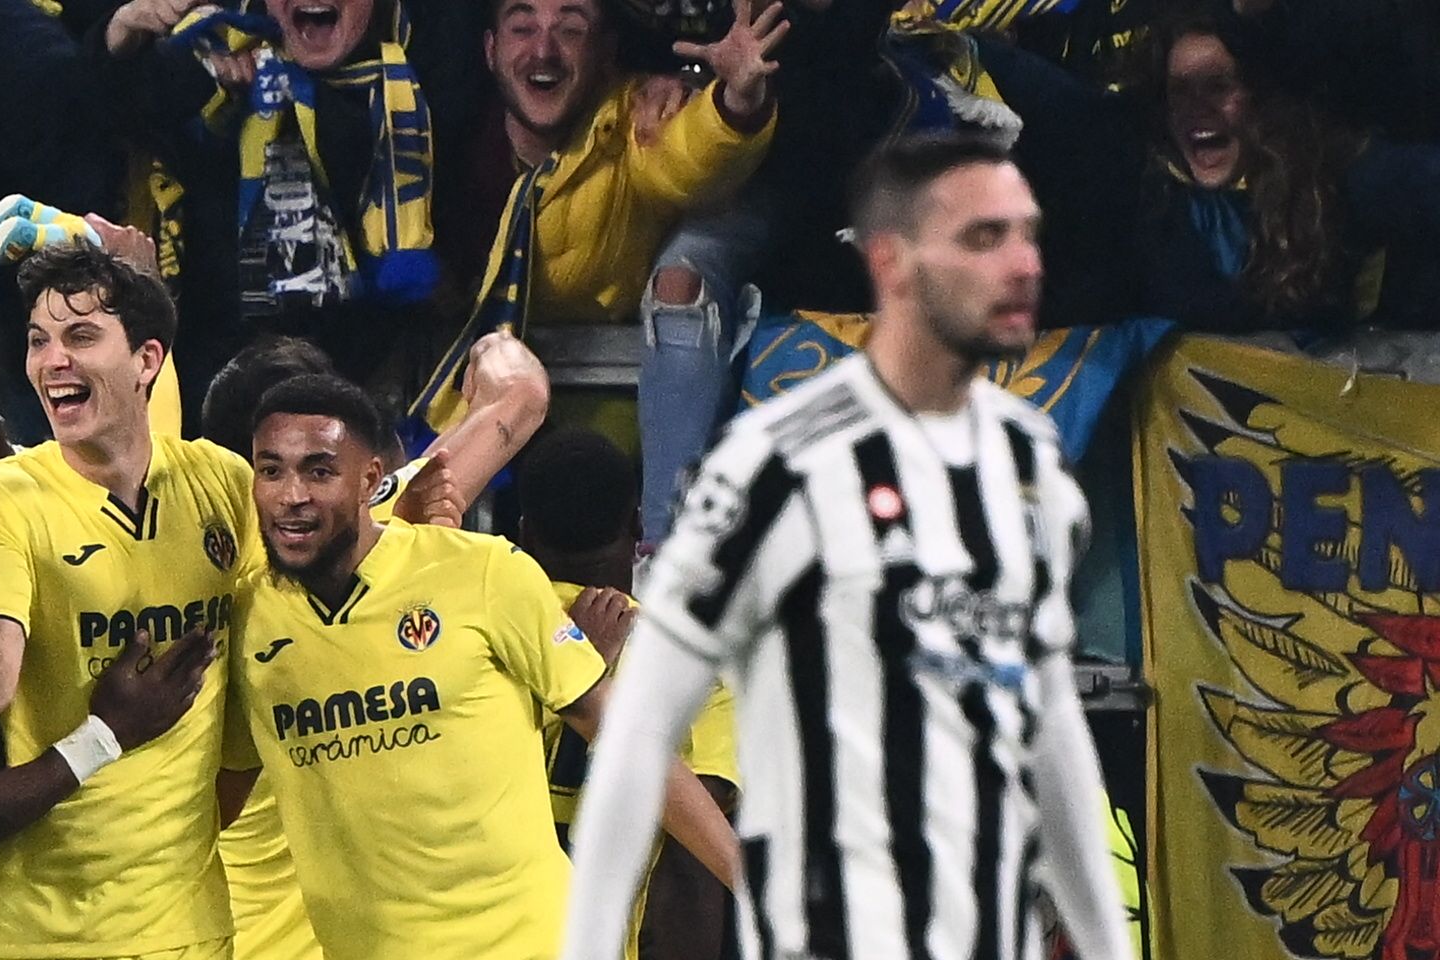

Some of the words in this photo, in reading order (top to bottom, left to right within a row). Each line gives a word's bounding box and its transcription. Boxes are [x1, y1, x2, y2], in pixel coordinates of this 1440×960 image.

[79, 592, 235, 648] PAMESA
[272, 676, 440, 741] PAMESA
[288, 723, 442, 768] cerámica
